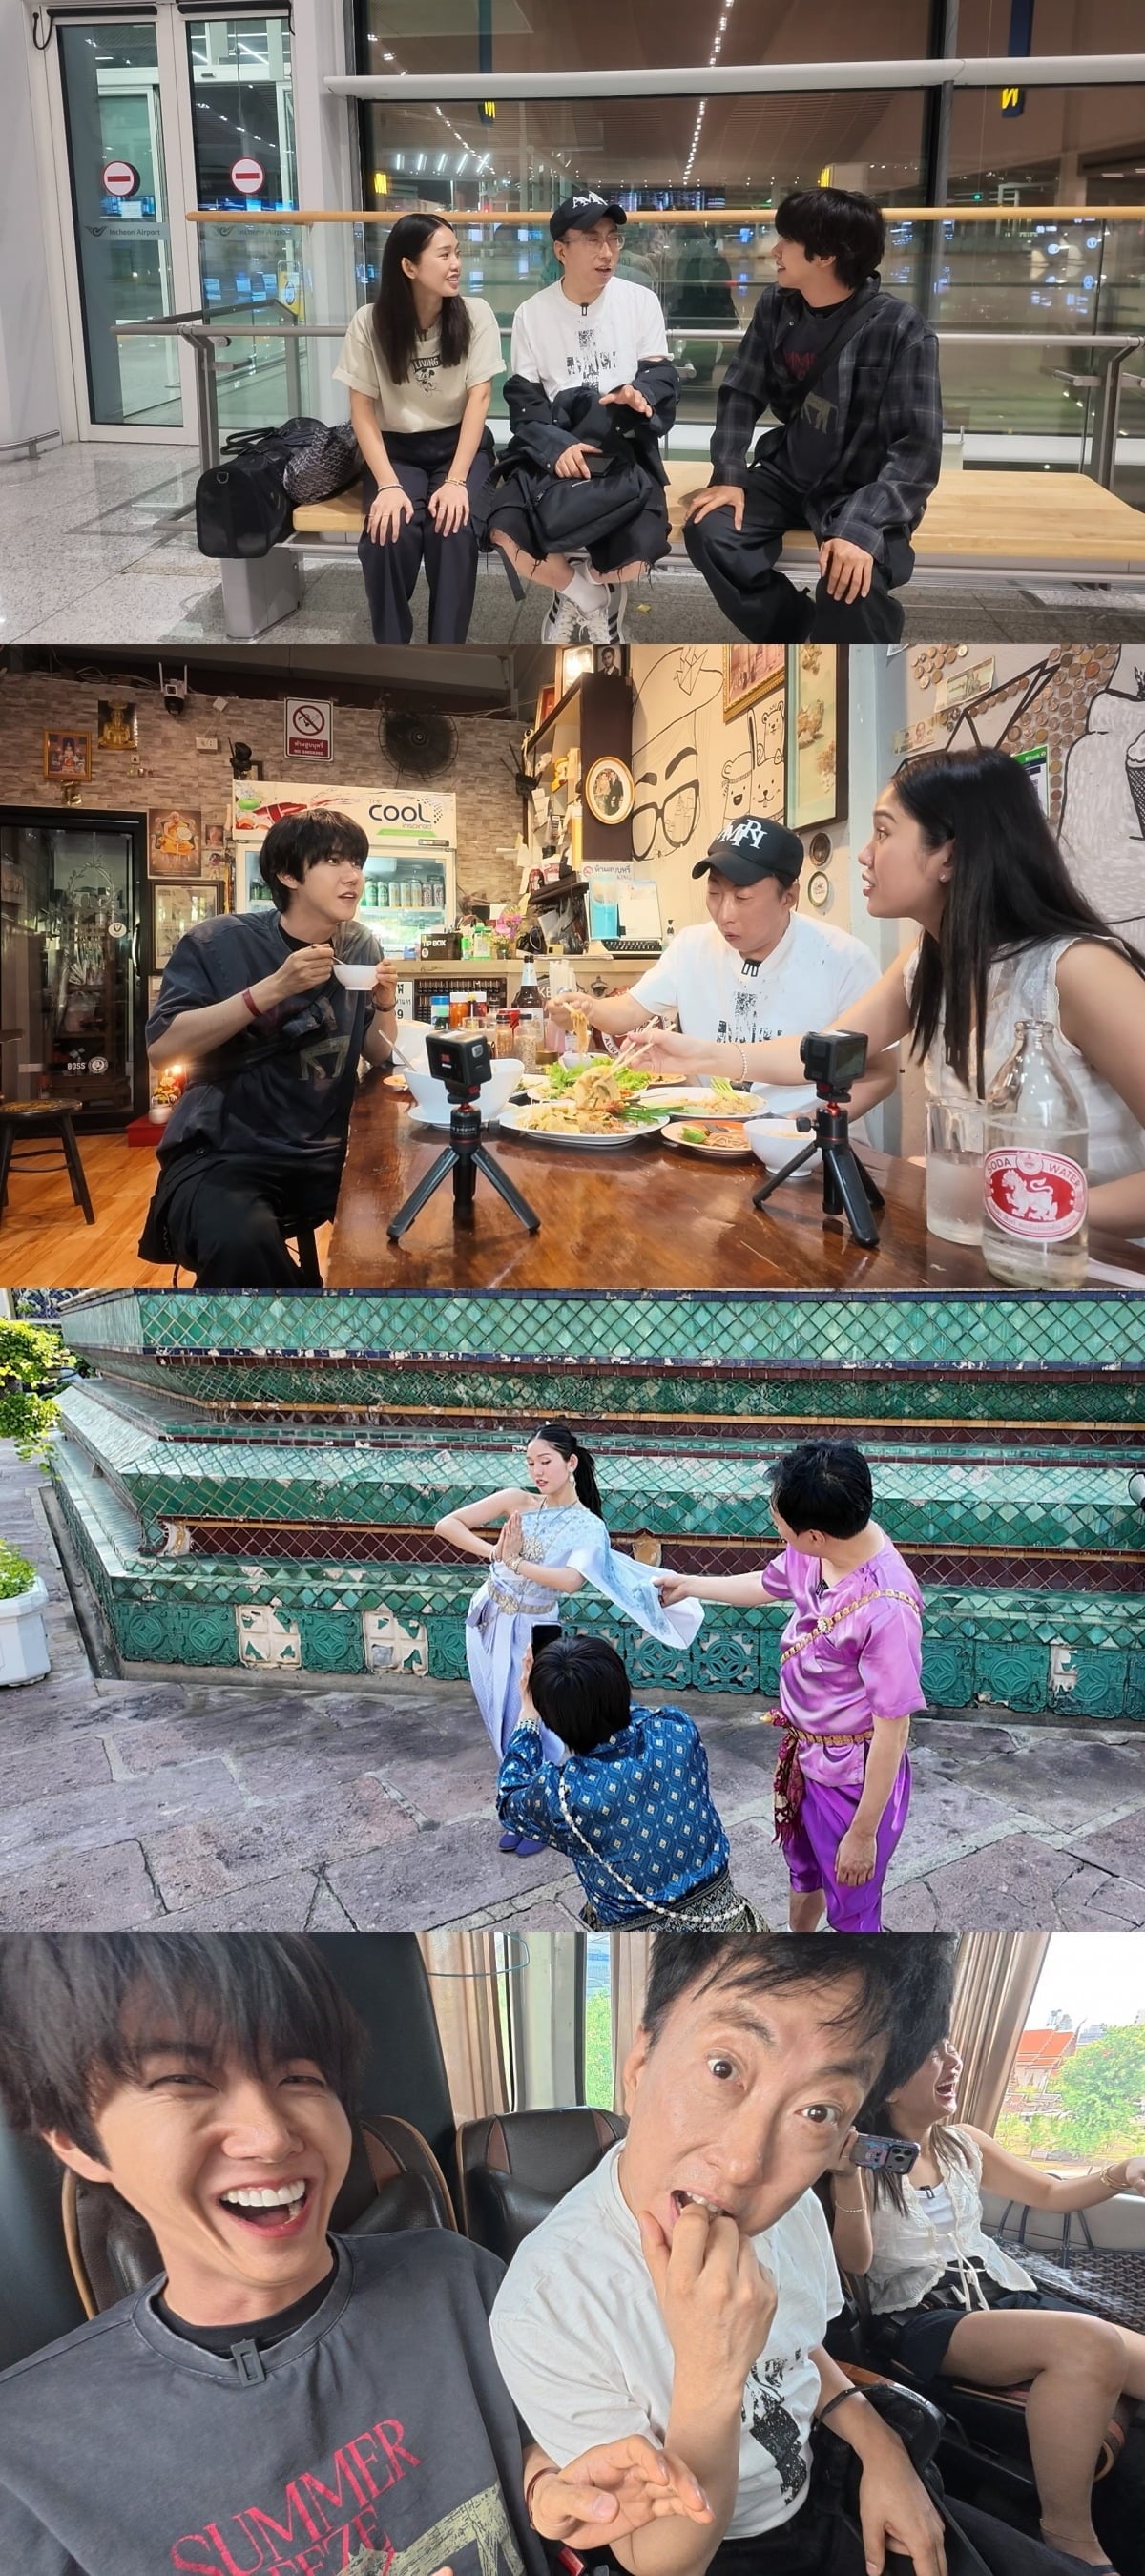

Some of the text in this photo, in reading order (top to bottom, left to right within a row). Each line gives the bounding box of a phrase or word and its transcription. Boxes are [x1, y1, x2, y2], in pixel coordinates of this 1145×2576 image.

[136, 228, 160, 237] Airport
[414, 357, 439, 369] LIVING
[987, 1157, 1081, 1188] SODA WATER
[170, 2419, 423, 2576] SUMMER
